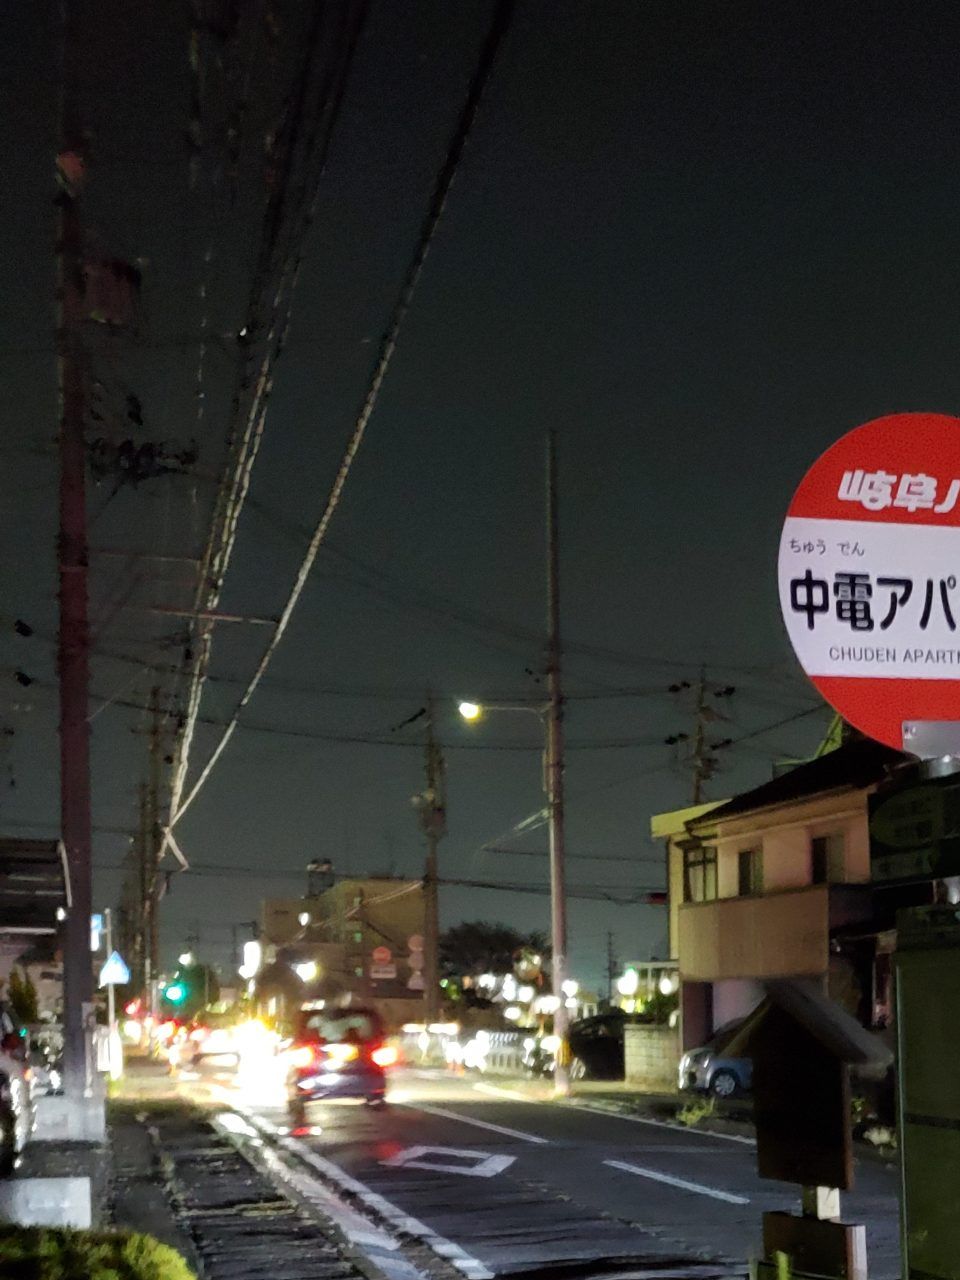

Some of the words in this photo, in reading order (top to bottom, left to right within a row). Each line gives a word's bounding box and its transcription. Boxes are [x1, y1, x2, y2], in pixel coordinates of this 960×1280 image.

[789, 539, 827, 556] ちゅう
[836, 540, 866, 558] でん
[828, 646, 897, 664] CHUDEN
